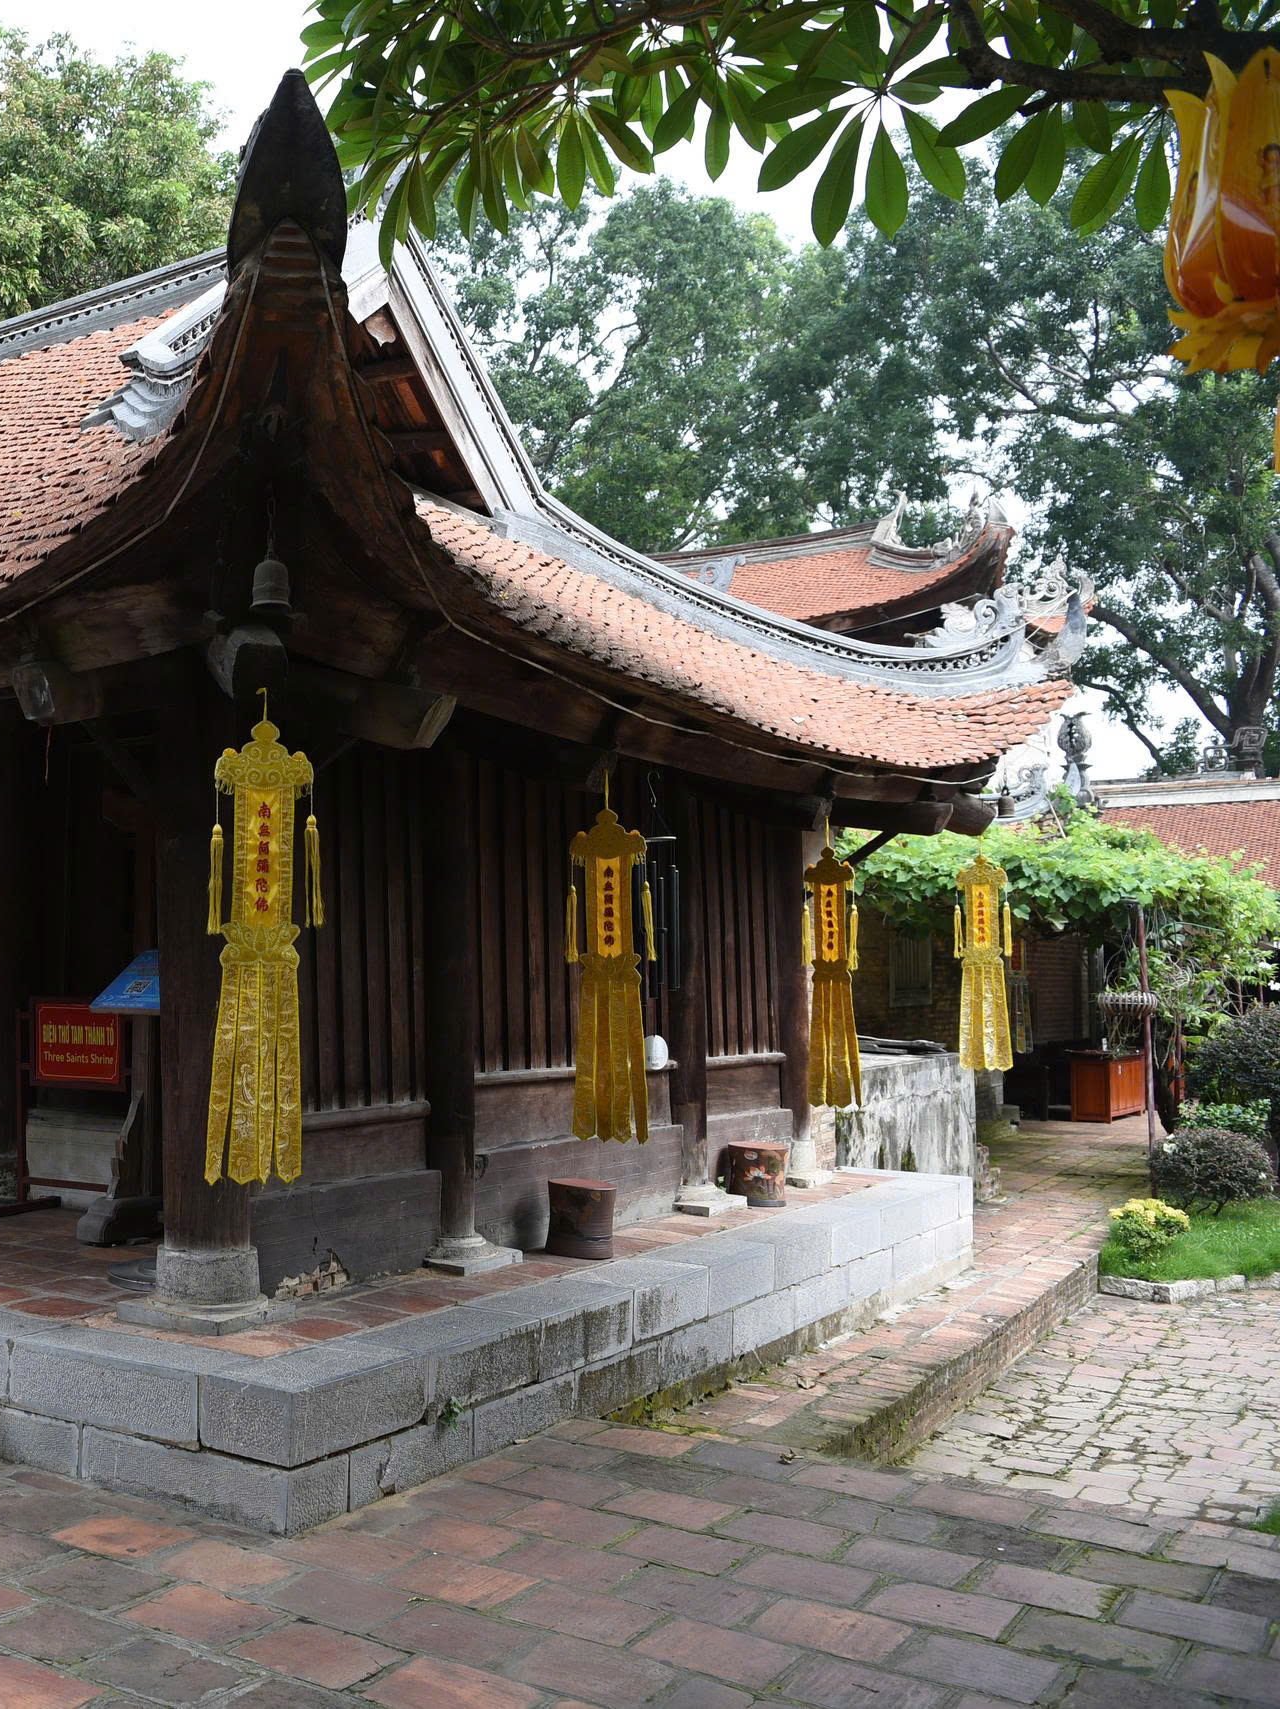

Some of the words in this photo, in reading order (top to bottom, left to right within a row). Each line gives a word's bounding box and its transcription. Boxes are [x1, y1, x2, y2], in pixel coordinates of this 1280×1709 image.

[255, 801, 272, 913] 南無阿彌陀佛
[71, 1025, 84, 1044] TAM
[85, 1021, 106, 1046] THÁNH
[44, 1050, 65, 1062] Three
[66, 1052, 89, 1063] Saints
[90, 1053, 114, 1065] Shrine
